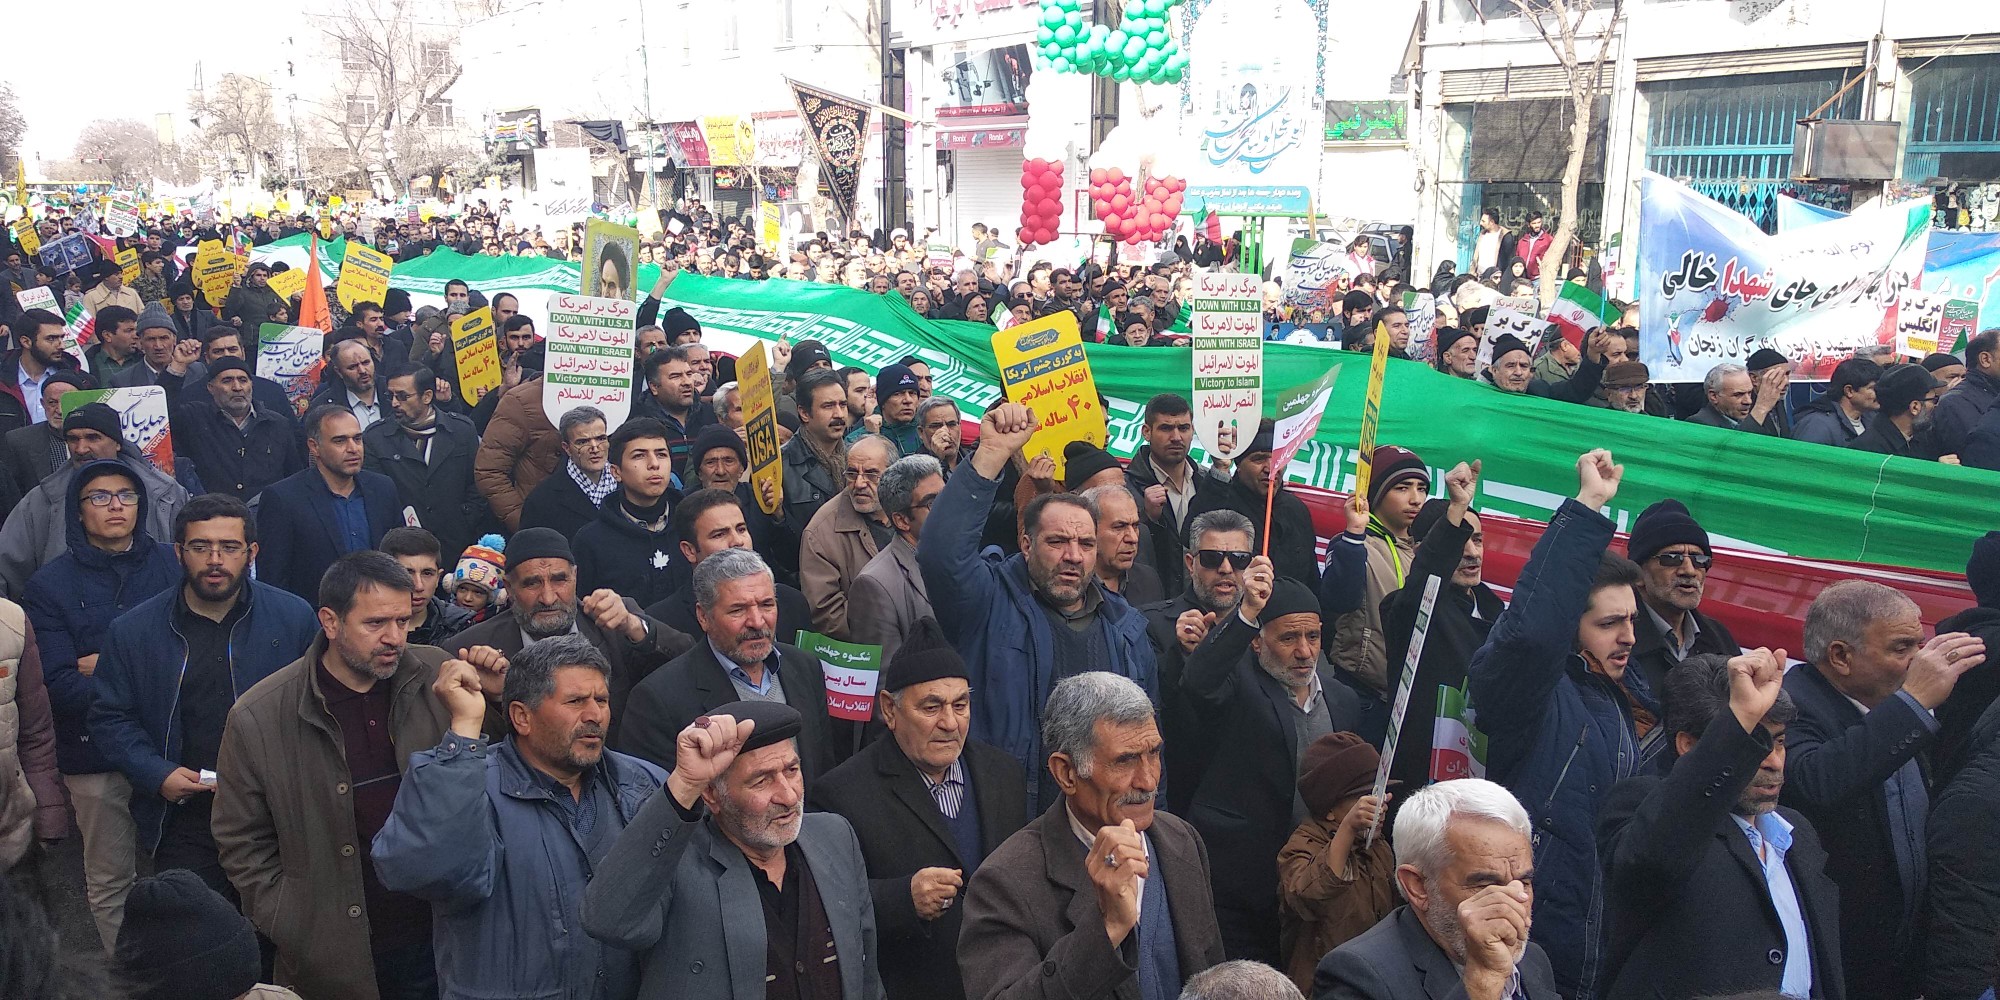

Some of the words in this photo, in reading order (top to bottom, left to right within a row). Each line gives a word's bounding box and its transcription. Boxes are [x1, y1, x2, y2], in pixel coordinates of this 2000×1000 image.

[988, 133, 1004, 141] Ronix
[345, 267, 368, 278] اسلامی
[368, 275, 387, 285] انقلاب
[1663, 253, 1717, 296] خالی
[344, 279, 353, 287] شد
[354, 283, 367, 292] ساله
[1200, 276, 1228, 297] امریکا
[1239, 277, 1257, 297] مرگ
[1723, 260, 1774, 303] شهدا
[370, 285, 381, 296] ۴۰
[1228, 284, 1238, 297] بر
[559, 296, 592, 313] امریکا
[594, 305, 605, 317] بر
[607, 300, 629, 317] مرگ
[1196, 300, 1219, 310] DOWN
[1220, 300, 1239, 311] WITH
[1240, 301, 1258, 311] U.S.A
[1521, 301, 1534, 311] مرگ
[1901, 298, 1912, 312] بر
[1914, 297, 1942, 316] مرگ
[552, 313, 581, 324] DOWN
[582, 316, 606, 326] WITH
[607, 318, 630, 328] U.S.A
[1201, 314, 1233, 335] لامریکا
[1233, 316, 1257, 335] الموت
[1493, 316, 1509, 330] بر
[1899, 316, 1938, 334] انگلیس
[477, 328, 488, 341] کوری
[558, 325, 598, 343] لامریکا
[1511, 320, 1542, 340] مرگ
[456, 337, 469, 349] آمریکا
[468, 333, 478, 343] چشم
[599, 331, 629, 346] الموت
[1196, 338, 1217, 348] DOWN
[1218, 338, 1236, 348] WITH
[1236, 338, 1258, 348] ISRAEL
[1907, 336, 1921, 344] DOWN
[1921, 338, 1937, 346] WITH
[477, 339, 495, 355] انقلاب
[550, 343, 577, 353] DOWN
[578, 345, 600, 355] WITH
[601, 347, 630, 357] ISRAEL
[1074, 348, 1082, 359] به
[1688, 334, 1723, 358] زنجان
[1908, 343, 1932, 352] ENGLAND
[458, 346, 478, 365] اسلامی
[482, 355, 496, 371] ۴۰
[1052, 349, 1073, 368] کوری
[471, 366, 484, 375] ساله
[553, 356, 597, 372] لاسرائیل
[600, 361, 629, 376] الموت
[1005, 361, 1032, 380] آمریکا
[1033, 359, 1052, 374] چشم
[1198, 354, 1234, 374] لاسرائیل
[1235, 354, 1259, 373] الموت
[462, 370, 472, 381] شد
[555, 373, 587, 385] Victory
[588, 375, 598, 384] to
[599, 376, 624, 386] Islam
[1054, 368, 1089, 393] انقلاب
[1200, 378, 1226, 390] Victory
[1227, 378, 1235, 387] to
[1236, 376, 1255, 387] Islam
[557, 387, 594, 404] للاسلام
[1015, 379, 1055, 405] اسلامی
[1067, 394, 1092, 419] ۴۰
[1203, 392, 1232, 417] للاسلام
[1282, 392, 1311, 413] چهلمین
[1044, 411, 1069, 427] ساله
[751, 426, 774, 464] USA
[814, 643, 840, 660] چهلمین
[842, 651, 871, 662] شکوه
[824, 675, 842, 686] پیر
[842, 675, 867, 687] سال
[827, 695, 845, 708] اسلا
[845, 701, 870, 712] انقلاب
